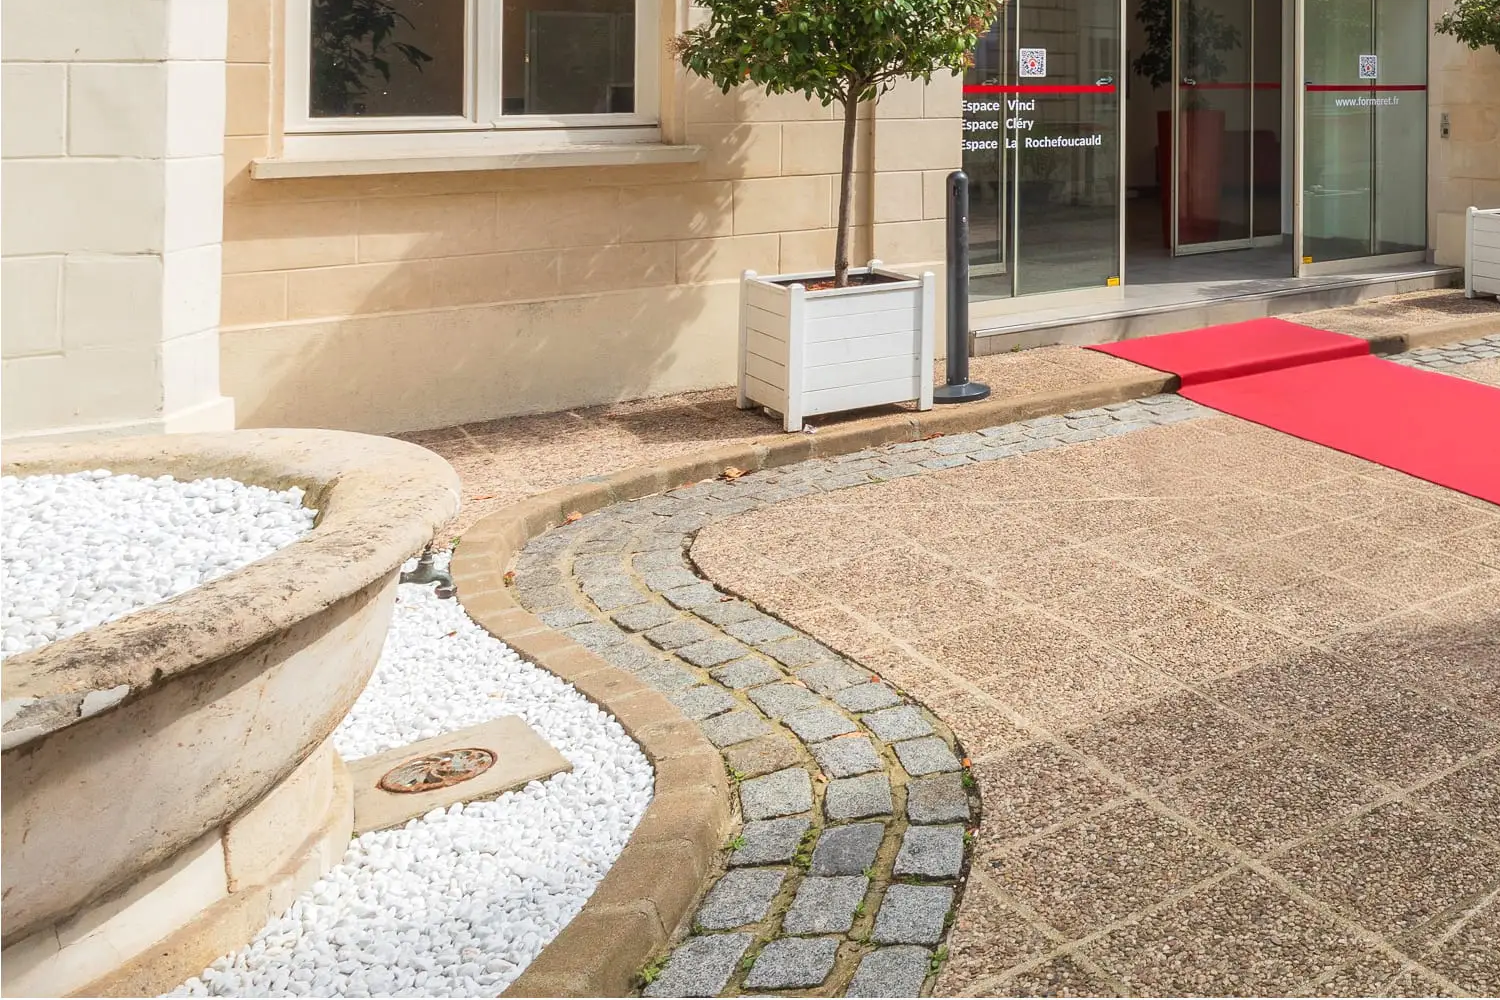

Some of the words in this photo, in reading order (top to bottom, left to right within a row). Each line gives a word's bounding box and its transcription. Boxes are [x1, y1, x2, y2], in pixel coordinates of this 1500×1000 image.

[962, 100, 1000, 113] Espace
[1007, 99, 1035, 111] Vinci
[1335, 96, 1399, 107] www.formeret.fr
[961, 119, 999, 130] Espace
[1006, 117, 1034, 131] Cléry
[961, 139, 998, 151] Espace
[1005, 138, 1017, 149] La
[1025, 134, 1102, 148] Rochefoucauld
